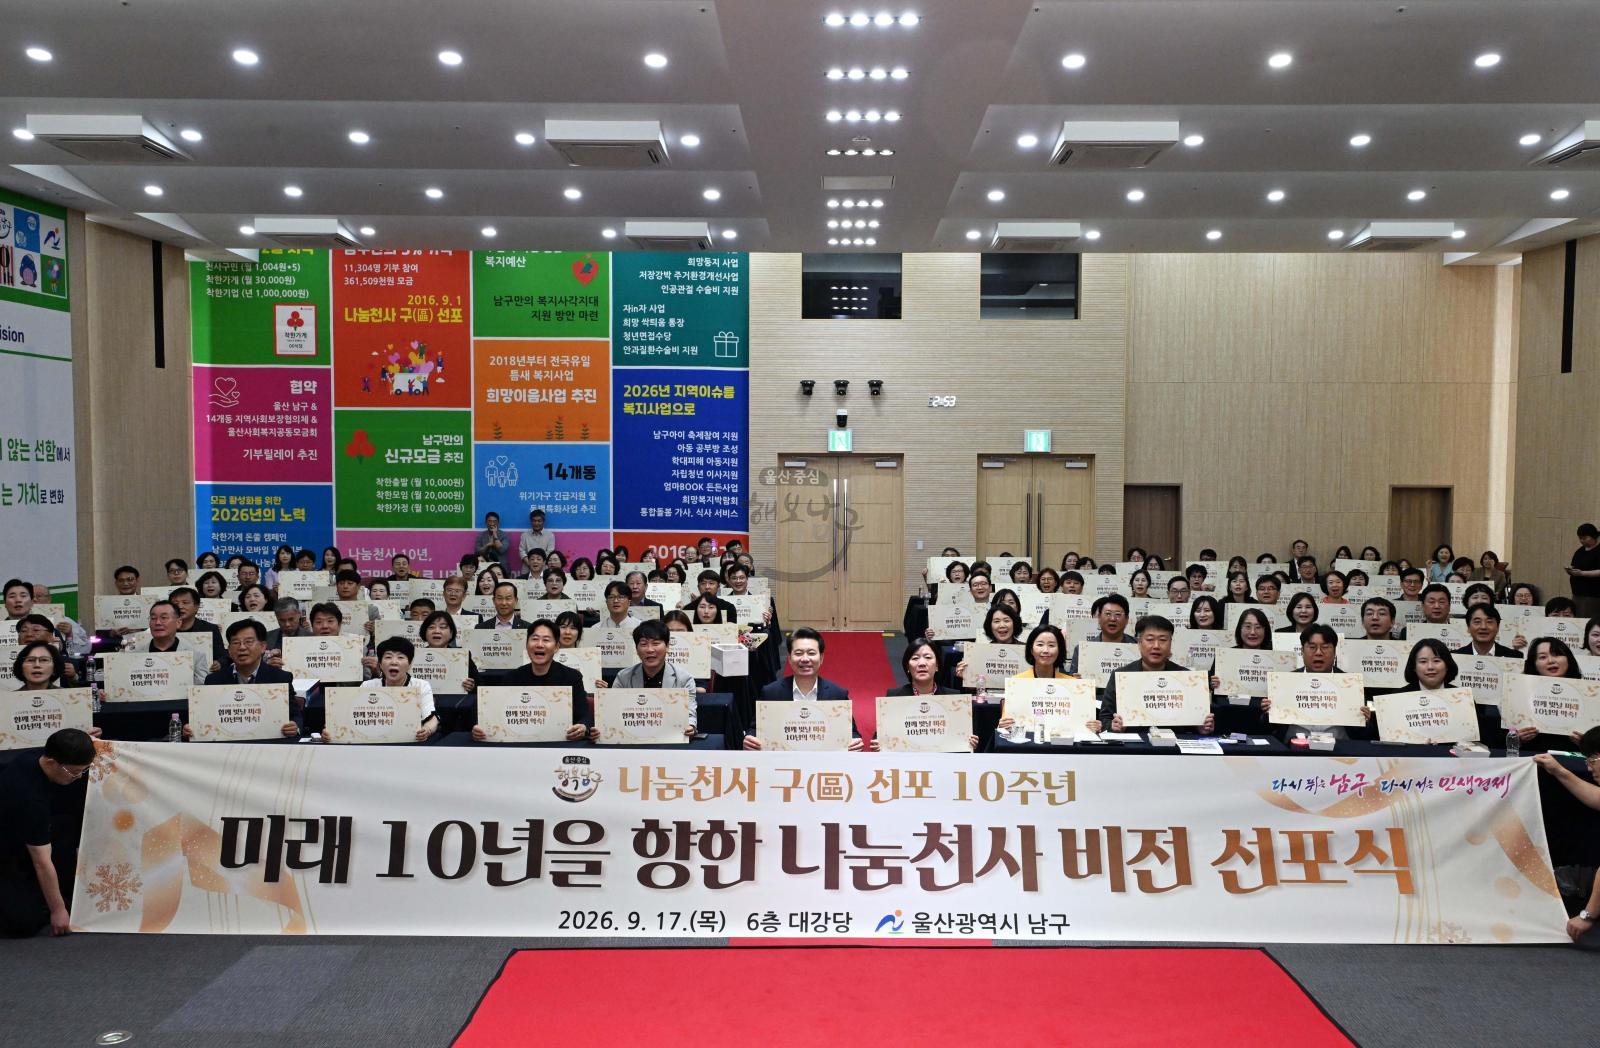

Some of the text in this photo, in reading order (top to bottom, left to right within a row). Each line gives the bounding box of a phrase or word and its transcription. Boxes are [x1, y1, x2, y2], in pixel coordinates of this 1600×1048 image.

[484, 256, 526, 268] 복지예산
[688, 257, 738, 268] 희망둥지 사업
[344, 264, 418, 273] 11,304명 기부 참여
[206, 276, 239, 285] 착한가게
[255, 276, 296, 286] 30,000원)
[344, 276, 414, 286] 361,509천원 모금
[639, 270, 738, 282] 저장강박 주거환경개선사업
[206, 288, 239, 298] 착한기업
[256, 288, 309, 298] 1,000,000원)
[661, 284, 738, 296] 인공관절 수술비 지원
[408, 294, 438, 306] 2016.
[442, 294, 452, 306] 9.
[493, 296, 598, 307] 남구만의 복지사각지대
[344, 307, 462, 322] 나눔천사 구(區) 선포
[649, 304, 665, 314] 사업
[531, 310, 598, 322] 지원 방안 마련
[622, 318, 638, 328] 희망
[668, 318, 684, 328] 통장
[622, 331, 672, 342] 청년면접수당
[622, 345, 698, 356] 안과질환수술비 지원
[490, 356, 590, 368] 2018년부터 전국유일
[509, 370, 574, 382] 틈새 복지사업
[290, 380, 317, 395] 협약
[623, 384, 735, 398] 2026년 지역이슈를
[486, 388, 597, 404] 희망이음사업 추진
[273, 402, 318, 411] 울산 남구 &
[623, 403, 696, 416] 복지사업으로
[206, 414, 318, 424] 14개동 지역사회보장협의체 &
[227, 427, 318, 438] 울산사회복지공동모금회
[653, 430, 738, 442] 남구아이 축제참여 지원
[422, 434, 464, 446] 남구만의
[7, 438, 30, 462] 않는
[34, 439, 70, 462] 선함에서
[242, 448, 318, 461] 기부릴레이 추진
[677, 444, 738, 454] 아동 공부방 조성
[384, 448, 464, 464] 신규모금 추진
[672, 456, 738, 467] 학대피해 아동지원
[544, 462, 596, 482] 14개동
[672, 469, 738, 480] 자립청년 이사지원
[376, 478, 464, 488] 착한출발 (월 10,000원)
[663, 482, 738, 492] 엄마BOOK 든든사업
[18, 482, 48, 506] 가치로
[50, 488, 64, 504] 변화
[376, 490, 464, 501] 착한모임 (월 20,000원)
[519, 492, 552, 501] 위기가구
[554, 492, 586, 501] 긴급지원
[210, 496, 282, 505] 모금 활성화를 위한
[682, 495, 738, 506] 희망복지박람회
[376, 503, 464, 514] 착한가정 (월 10,000원)
[580, 504, 597, 514] 추진
[640, 507, 672, 518] 통합돌봄
[696, 508, 712, 518] 식사
[714, 508, 738, 518] 서비스
[212, 508, 306, 522] 2026년의 노력
[212, 532, 243, 542] 착한가게
[264, 532, 287, 542] 캠페인
[246, 545, 269, 554] 모바일
[348, 548, 396, 561] 나눔천사
[618, 766, 1076, 806] 나눔천사 구(區) 선포 10주년
[1272, 772, 1512, 798] 다시 뛰는 남구 다시 서는 민생경제
[220, 814, 1417, 895] 미래 10년을 향한 나눔천사 비전 선포식
[558, 910, 726, 933] 2026. 9. 17.(목)
[746, 910, 853, 933] 6층 대강당
[912, 912, 1070, 935] 울산광역시 남구
